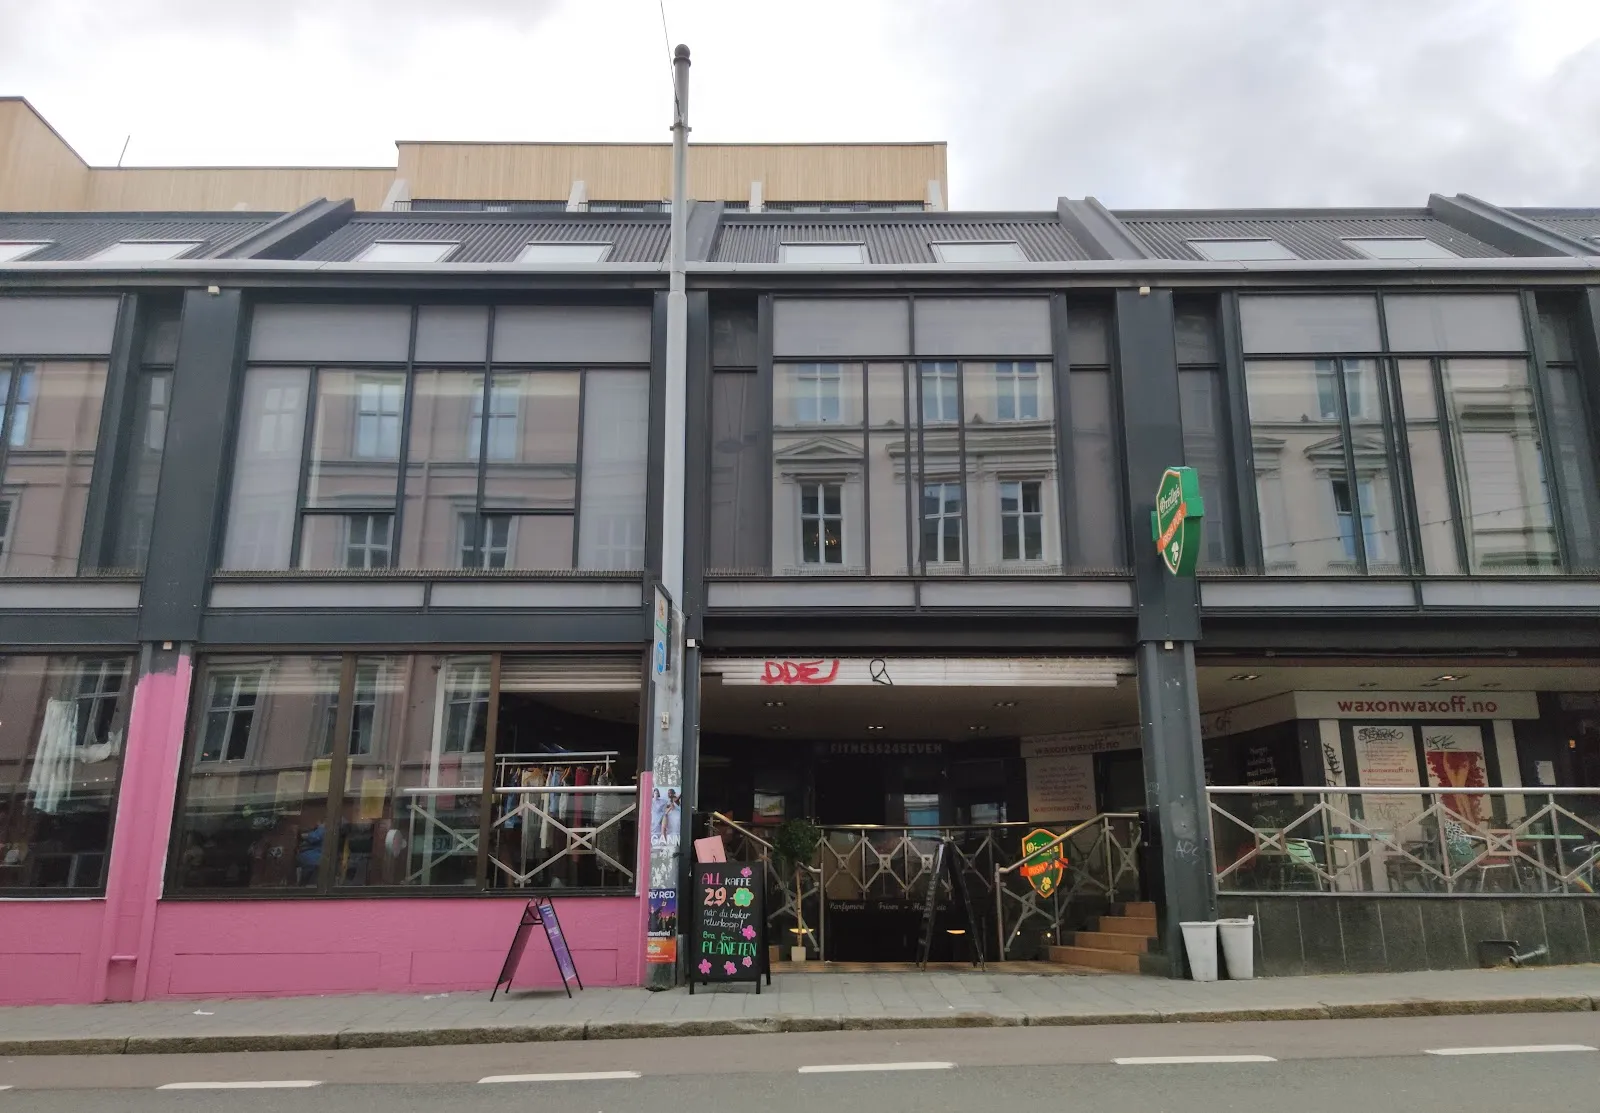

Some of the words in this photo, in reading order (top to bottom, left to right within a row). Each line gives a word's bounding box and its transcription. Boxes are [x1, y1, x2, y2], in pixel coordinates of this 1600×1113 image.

[1337, 695, 1498, 713] waxonwaxoff.no
[702, 872, 723, 885] ALL
[725, 877, 751, 886] KAFFE
[659, 890, 675, 898] RED
[719, 908, 728, 918] du
[702, 930, 716, 940] Bra
[702, 941, 757, 957] PLANETEN
